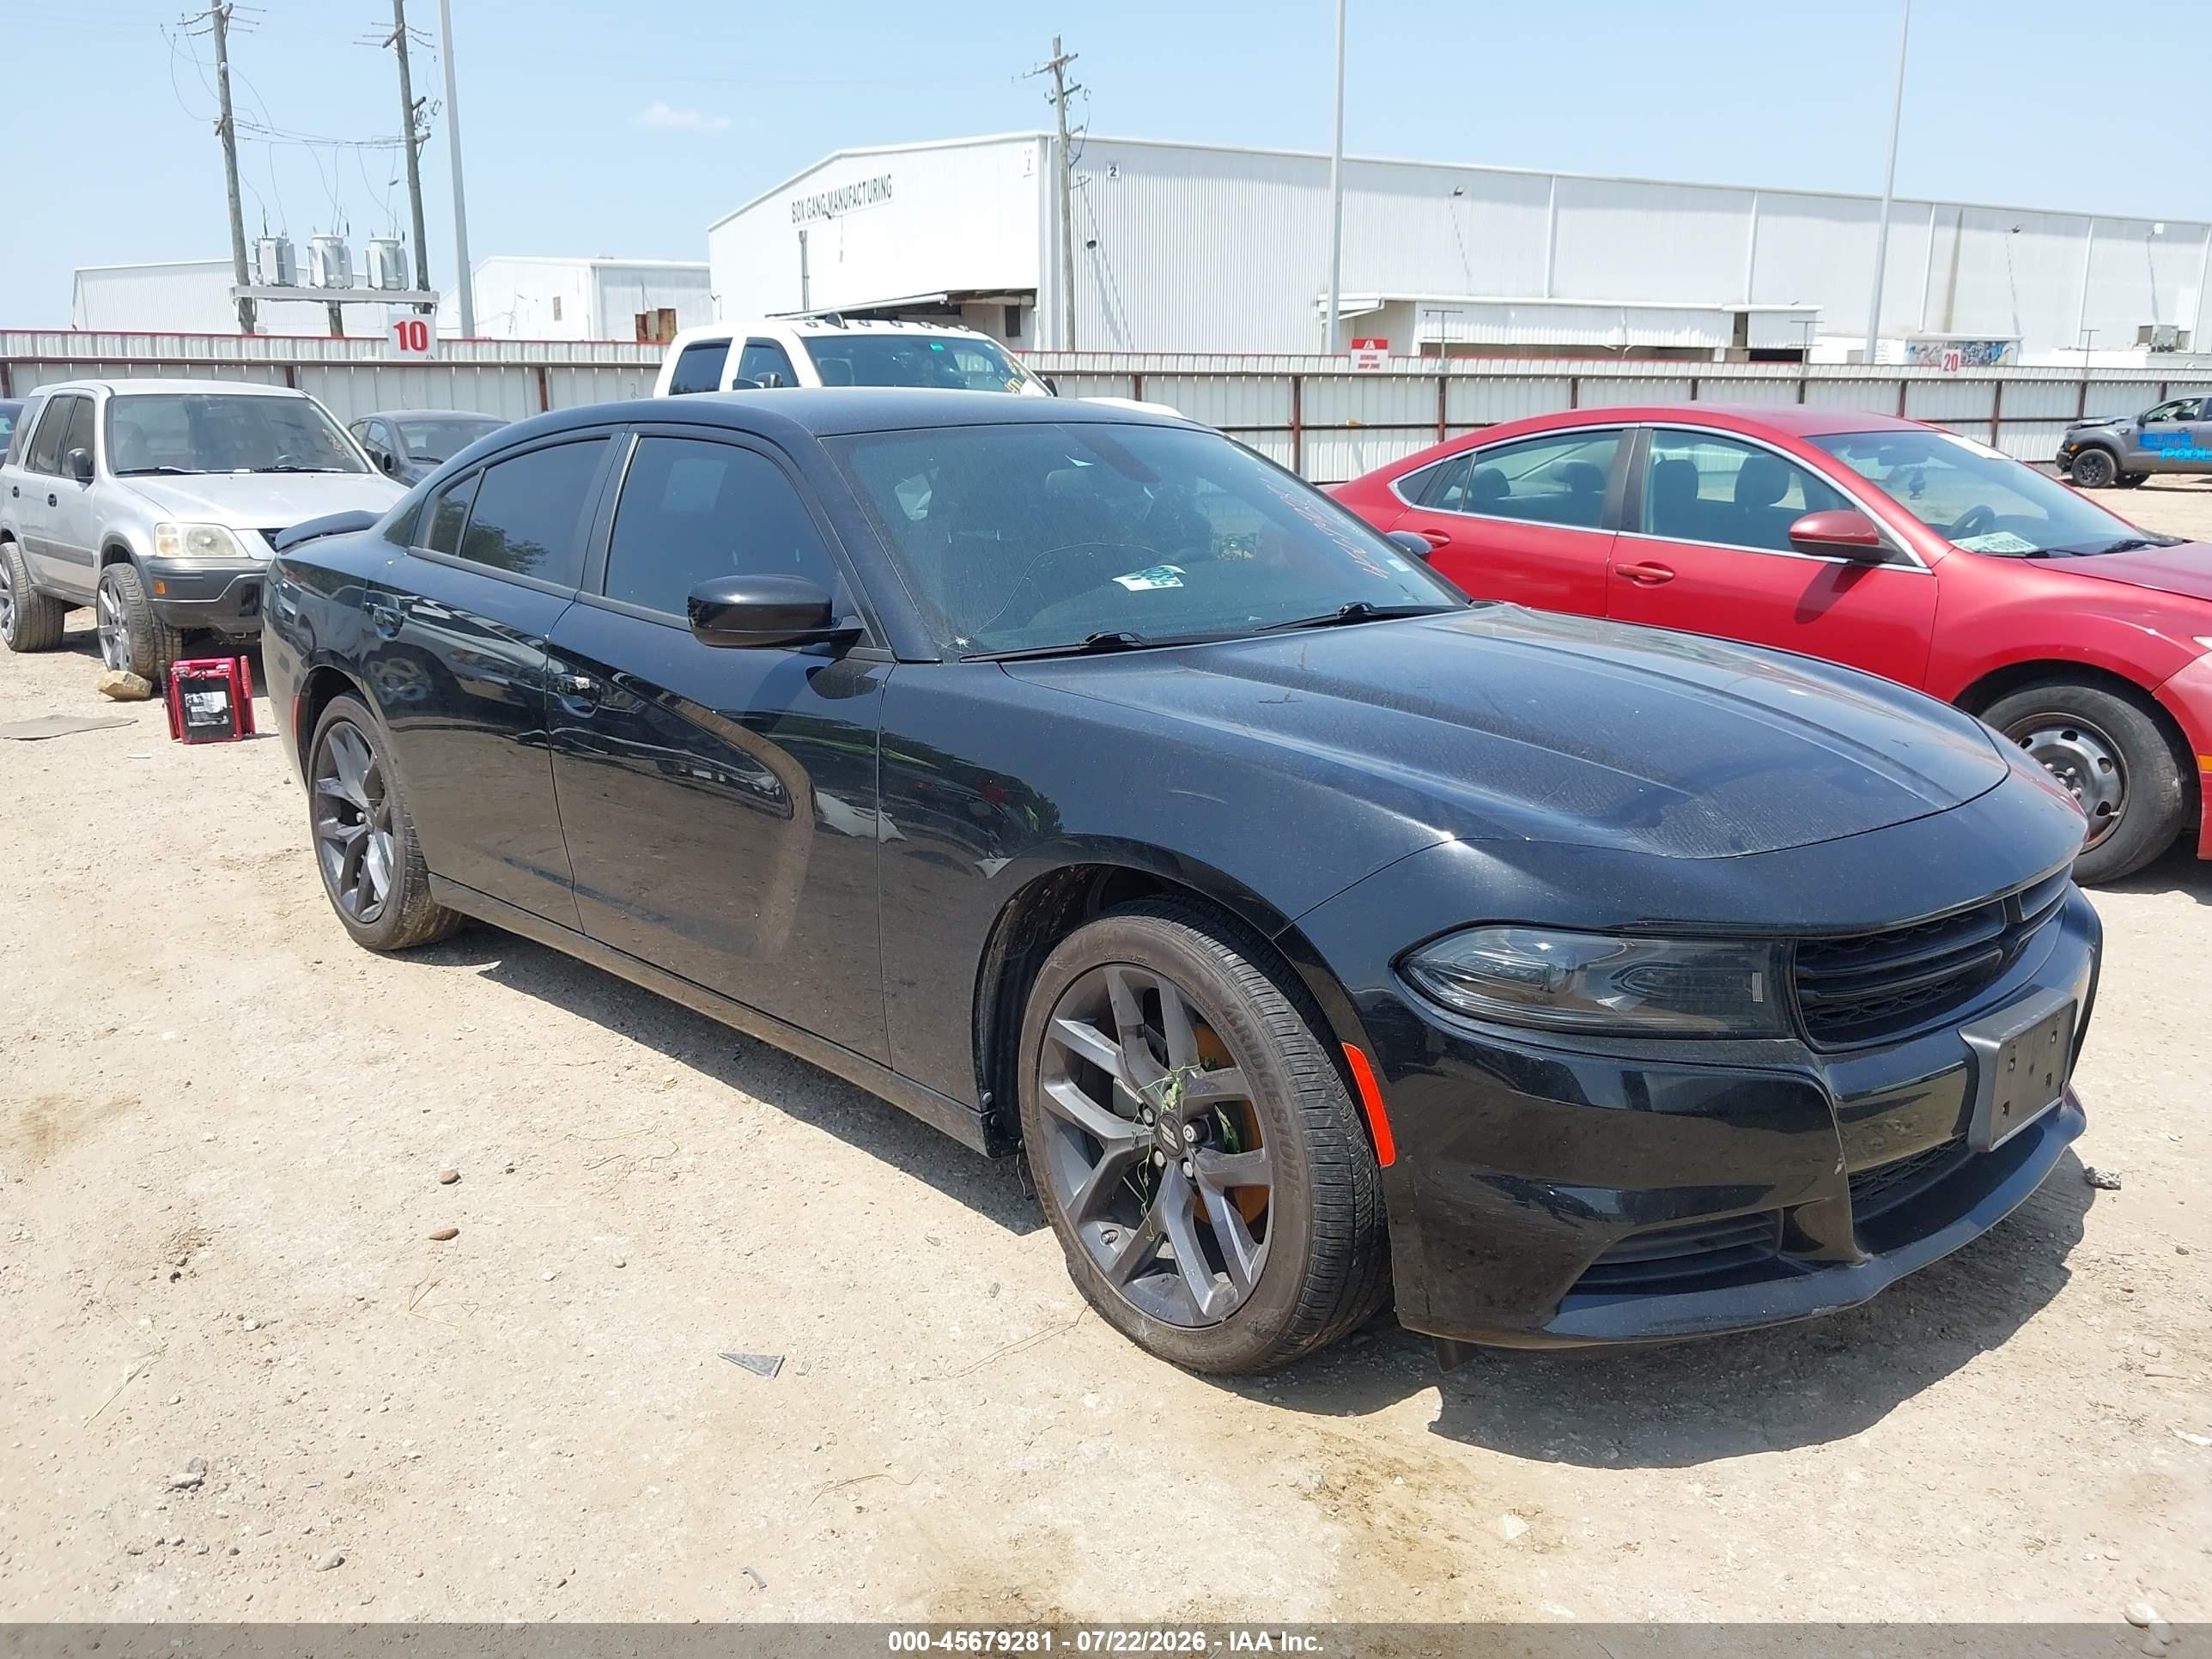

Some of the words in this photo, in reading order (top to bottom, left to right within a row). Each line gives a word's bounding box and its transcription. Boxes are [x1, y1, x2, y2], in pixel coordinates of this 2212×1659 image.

[1110, 166, 1117, 177] 2
[792, 198, 805, 224] BOX
[807, 193, 826, 220] GANG
[828, 173, 892, 212] MANUFACTURING
[393, 321, 428, 351] 10
[1943, 354, 1959, 372] 20
